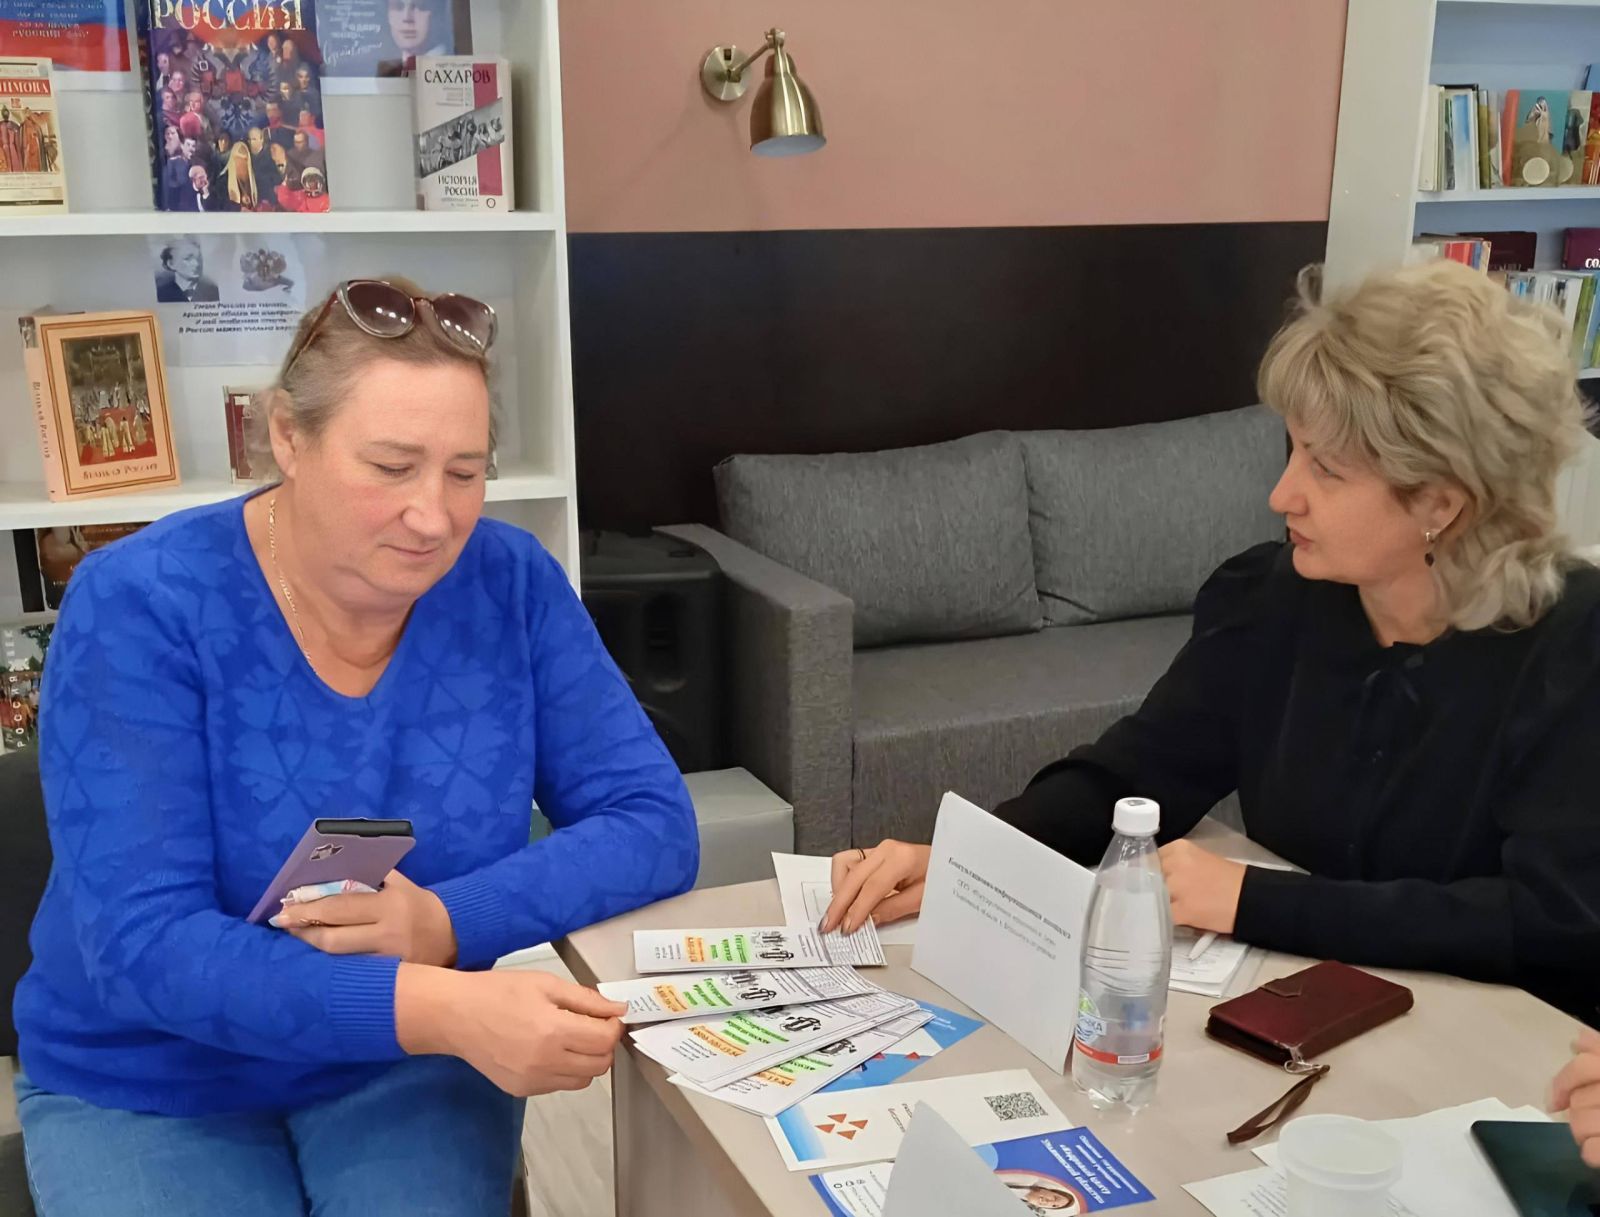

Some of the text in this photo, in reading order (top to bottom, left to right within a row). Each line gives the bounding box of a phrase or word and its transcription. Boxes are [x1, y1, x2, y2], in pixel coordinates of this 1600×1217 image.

[153, 0, 306, 30] РОССИЯ
[424, 69, 490, 84] САХАРОВ
[438, 175, 477, 184] ИСТОРИЯ
[444, 186, 478, 196] РОССИИ
